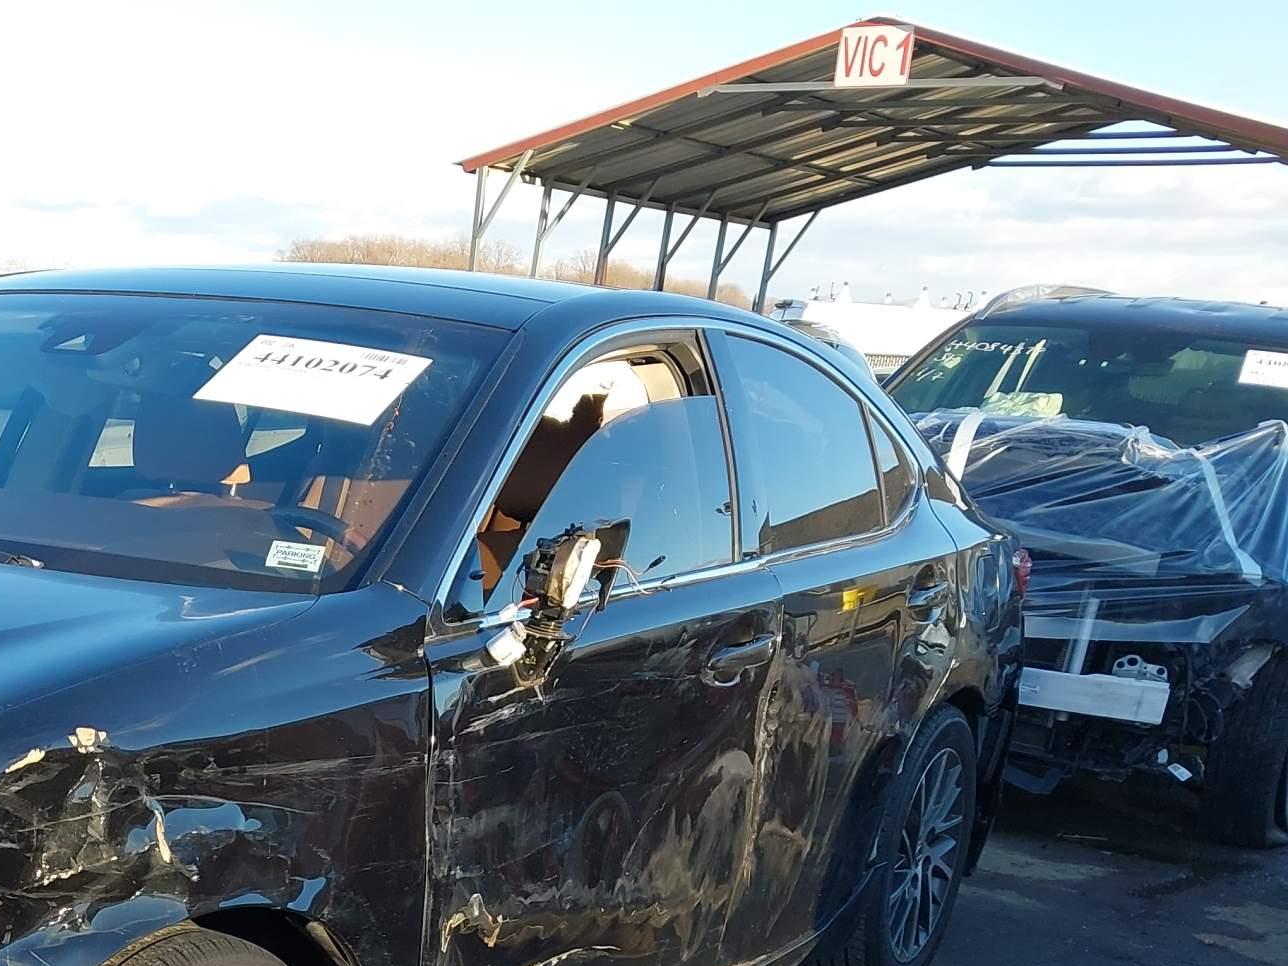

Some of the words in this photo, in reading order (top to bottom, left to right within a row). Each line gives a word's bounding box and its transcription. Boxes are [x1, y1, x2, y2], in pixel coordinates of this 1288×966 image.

[844, 34, 888, 78] VIC
[896, 32, 912, 76] 1
[254, 352, 394, 380] 44102074
[275, 549, 317, 560] PARKING
